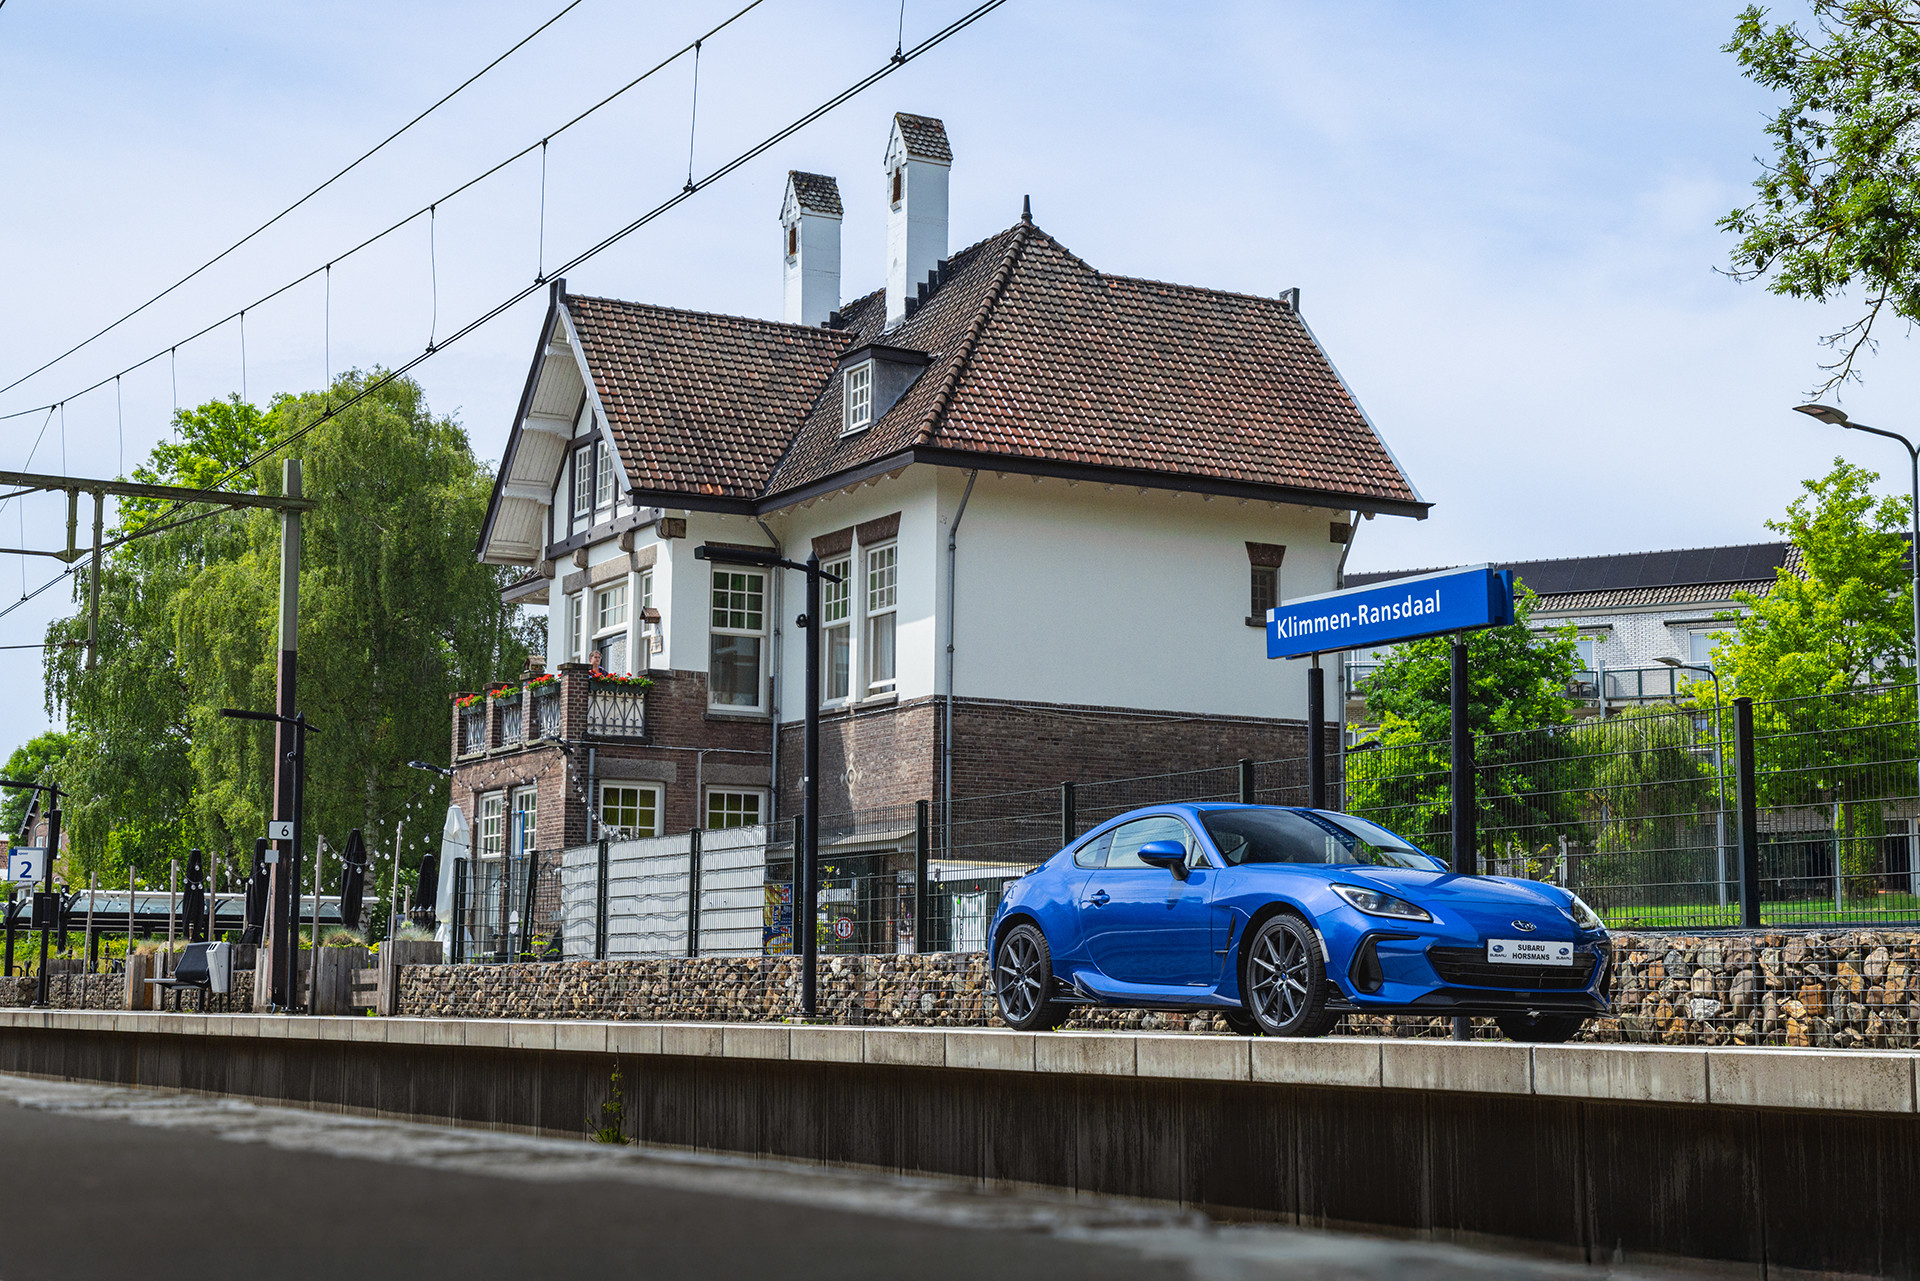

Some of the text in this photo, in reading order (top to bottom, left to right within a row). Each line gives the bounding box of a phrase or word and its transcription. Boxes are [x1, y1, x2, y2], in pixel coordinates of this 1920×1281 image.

[1277, 590, 1440, 639] Klimmen-Ransdaal
[281, 825, 289, 837] 6
[19, 861, 32, 878] 2
[1517, 944, 1546, 952] SUBARU
[1512, 953, 1550, 961] HORSMANS
